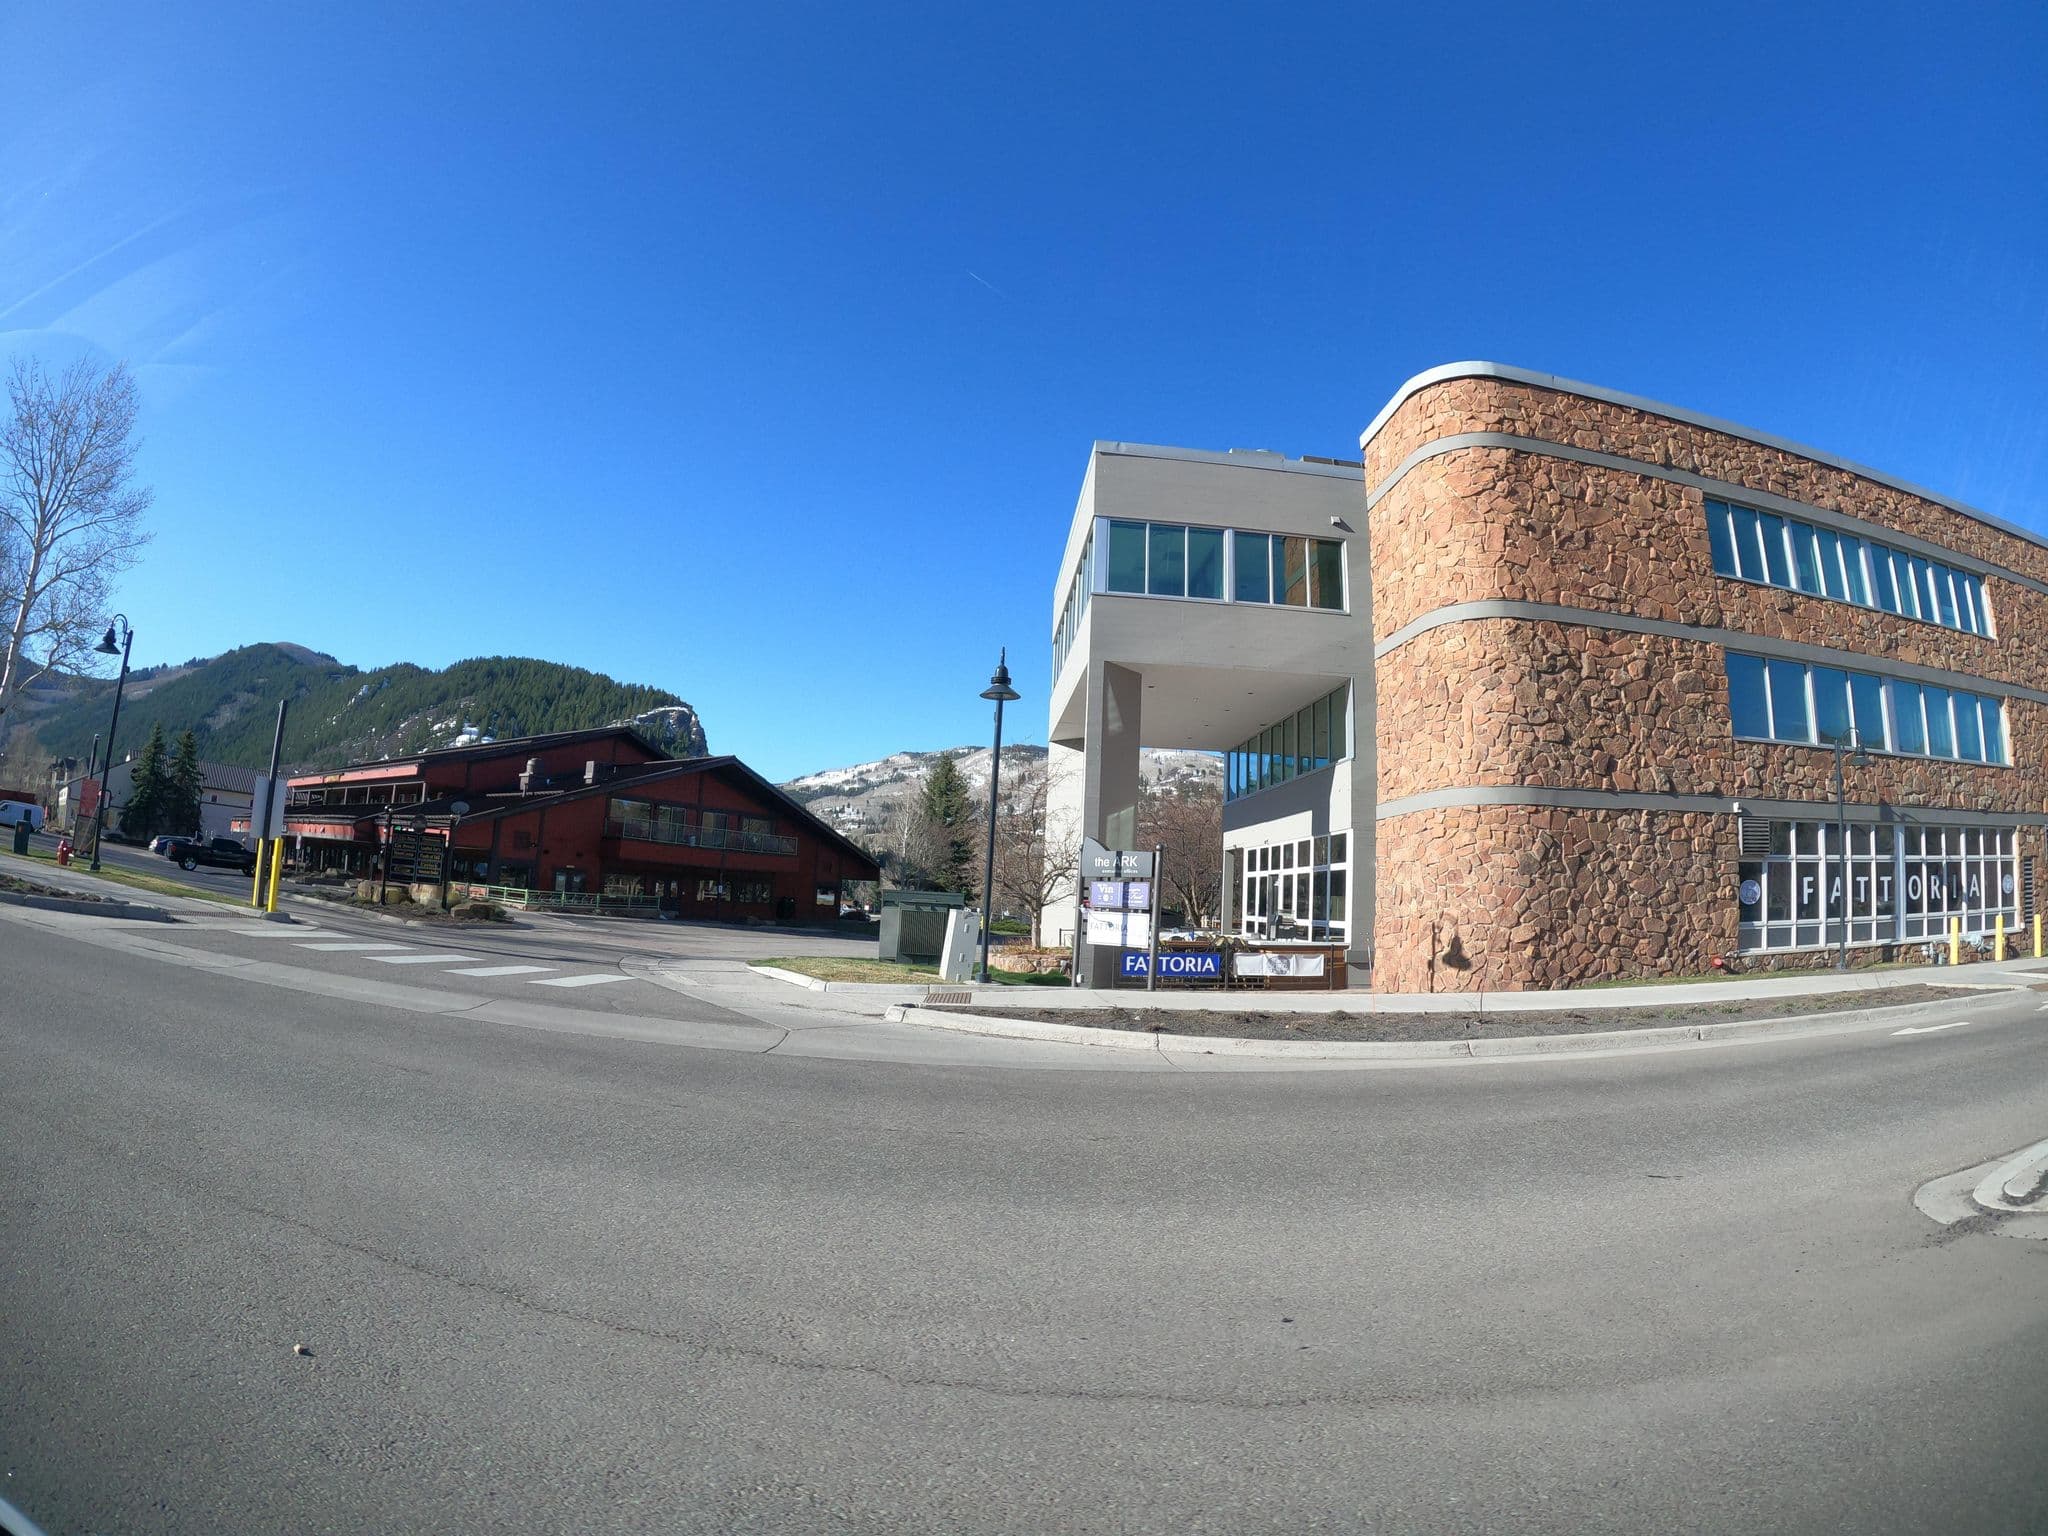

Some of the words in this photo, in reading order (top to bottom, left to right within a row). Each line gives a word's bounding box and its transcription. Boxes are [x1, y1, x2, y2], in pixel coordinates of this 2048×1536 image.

[1094, 857, 1110, 867] the
[1112, 855, 1138, 867] ARK
[1802, 874, 1980, 905] FATTORIA
[1125, 956, 1216, 972] FATORIA
